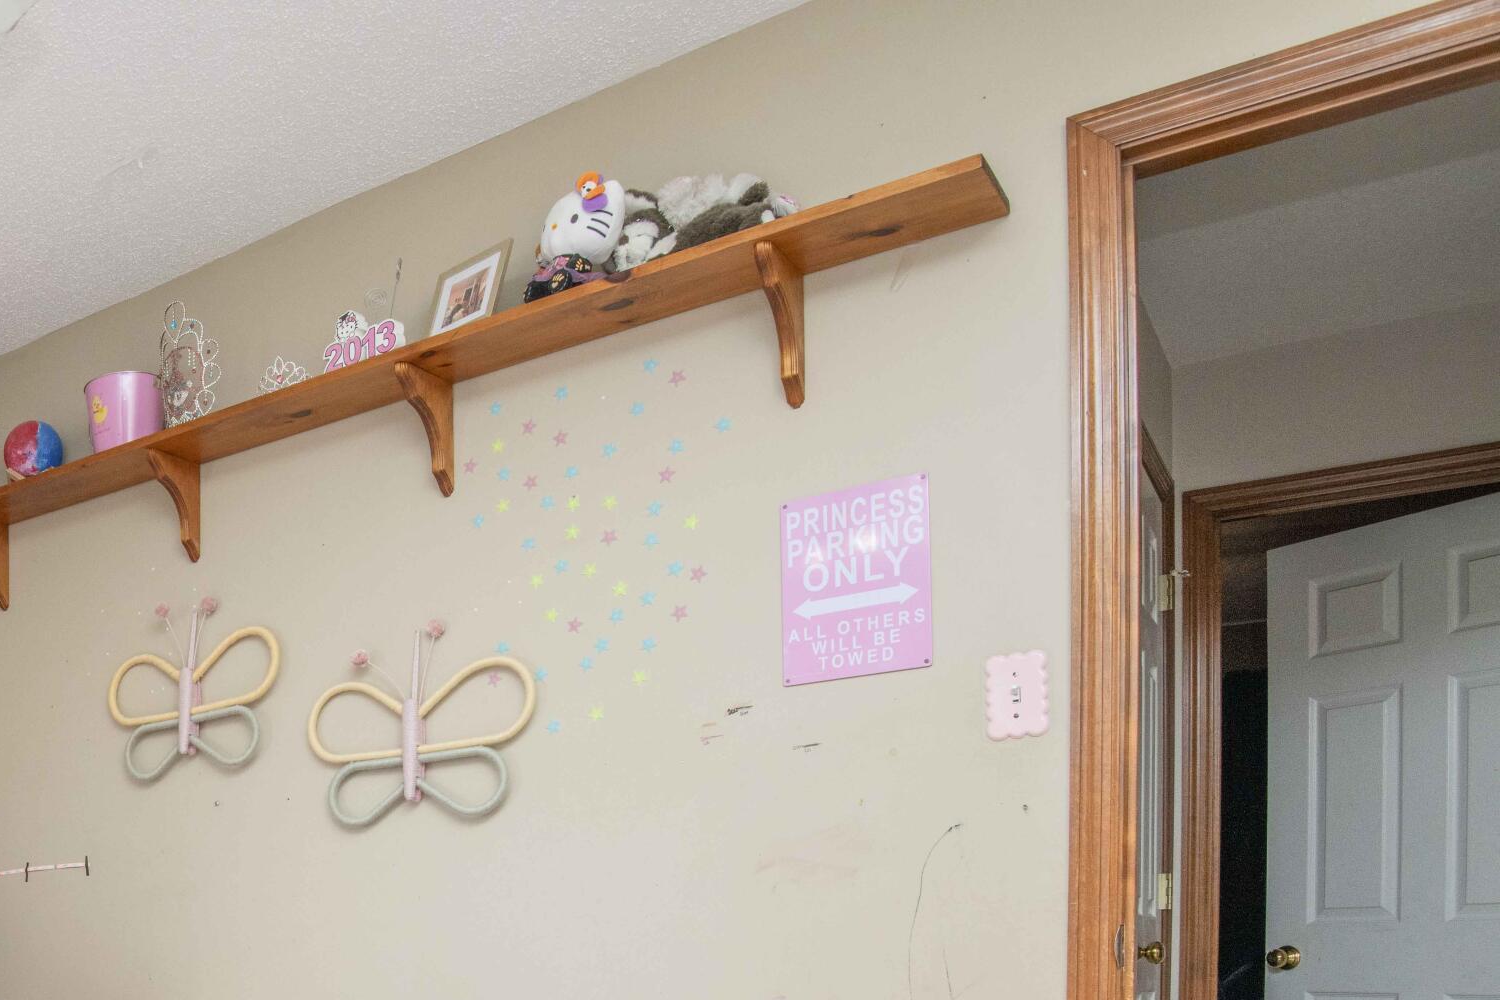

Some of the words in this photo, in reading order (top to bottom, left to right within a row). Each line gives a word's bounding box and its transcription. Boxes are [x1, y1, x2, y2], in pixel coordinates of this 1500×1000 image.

[325, 321, 396, 372] 2013
[786, 484, 925, 540] PRINCESS
[787, 514, 925, 568] PARKING
[803, 546, 909, 592] ONLY
[788, 624, 827, 643] ALL
[837, 608, 925, 635] OTHERS
[812, 635, 862, 655] WILL
[874, 628, 901, 645] BE
[818, 648, 894, 672] TOWED
